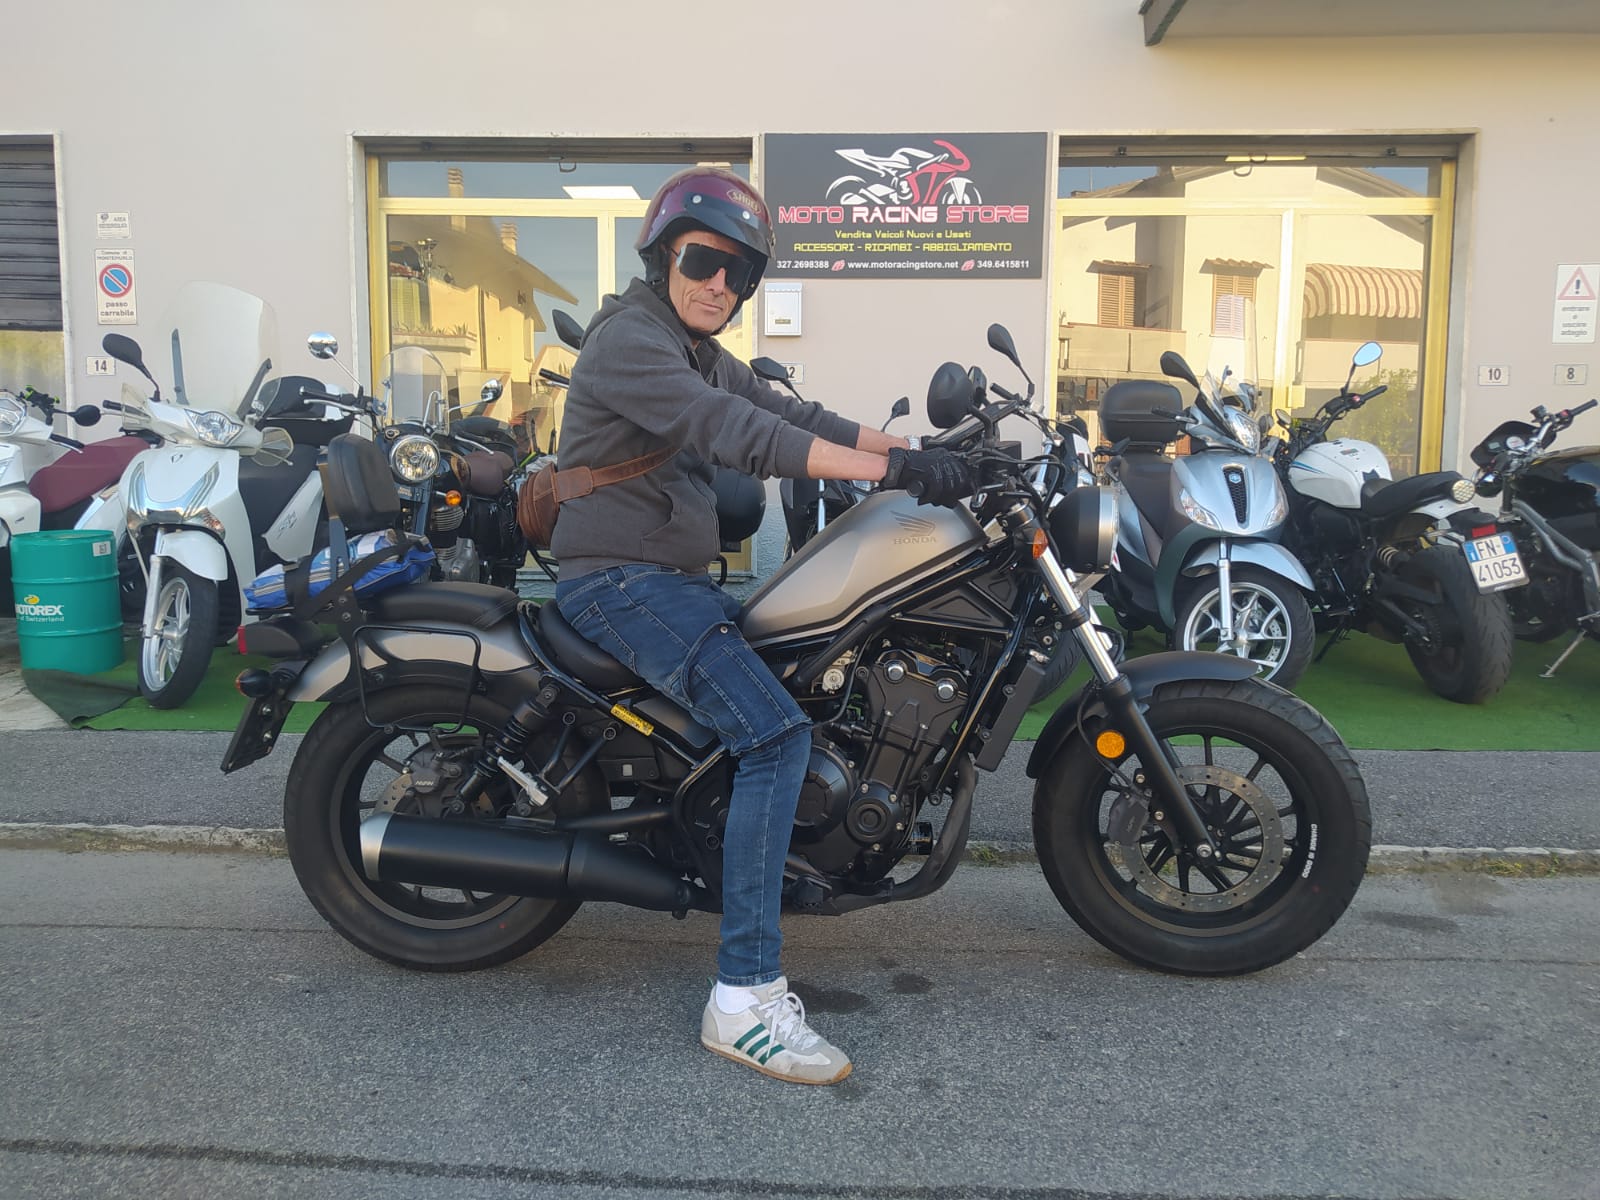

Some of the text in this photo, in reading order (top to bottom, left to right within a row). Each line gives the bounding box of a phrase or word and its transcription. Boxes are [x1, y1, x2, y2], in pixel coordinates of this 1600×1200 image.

[778, 205, 1030, 223] MOTO RACING STORE
[835, 230, 872, 239] Vendita
[875, 230, 904, 239] Veicoli
[907, 230, 934, 238] Nuovi
[945, 230, 972, 238] Usati
[794, 243, 854, 252] ACCESSORI
[864, 243, 913, 252] RICAMBI
[923, 242, 1012, 252] ABBIGLIAMENTO
[848, 260, 958, 270] www.motoracingstore.net
[977, 260, 1029, 268] 349.6415811
[94, 360, 107, 372] 14
[1488, 368, 1501, 380] 10
[1567, 367, 1575, 380] 8
[1475, 539, 1498, 559] FN
[1479, 557, 1521, 582] 41053
